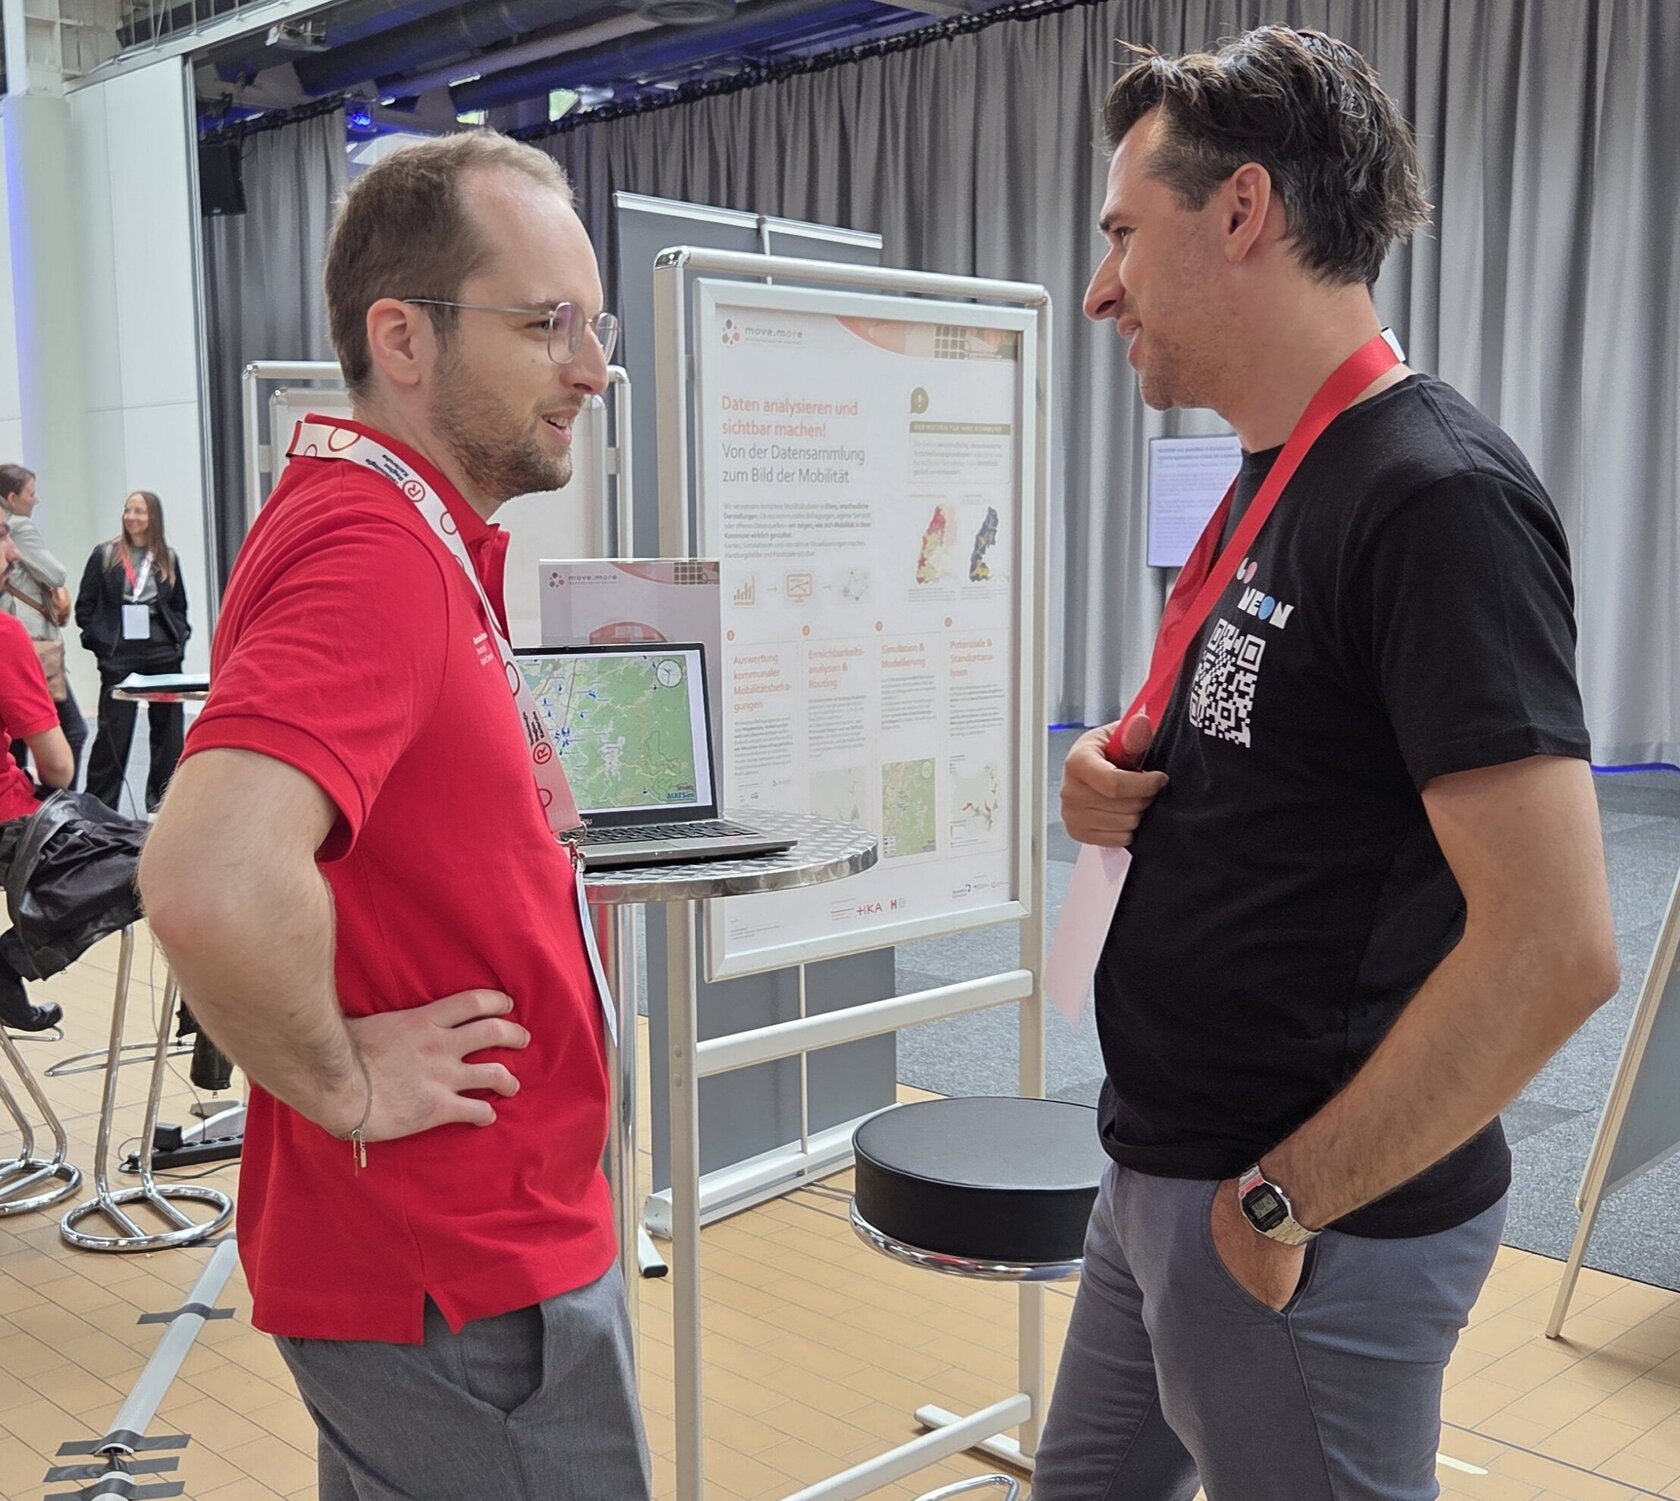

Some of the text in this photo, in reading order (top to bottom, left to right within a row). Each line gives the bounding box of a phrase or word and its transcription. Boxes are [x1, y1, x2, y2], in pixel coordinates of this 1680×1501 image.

[745, 326, 803, 339] move.more
[722, 395, 858, 417] Daten analysieren und
[722, 419, 826, 437] sichtbar machen!
[722, 443, 865, 465] Von der Datensammlung
[722, 467, 849, 484] zum Bild der Mobilität
[1237, 586, 1295, 629] NEON
[733, 654, 779, 665] Auswertung
[734, 668, 780, 680] kommunaler
[734, 682, 793, 696] Mobilitätsbefra-
[734, 701, 763, 713] gungen
